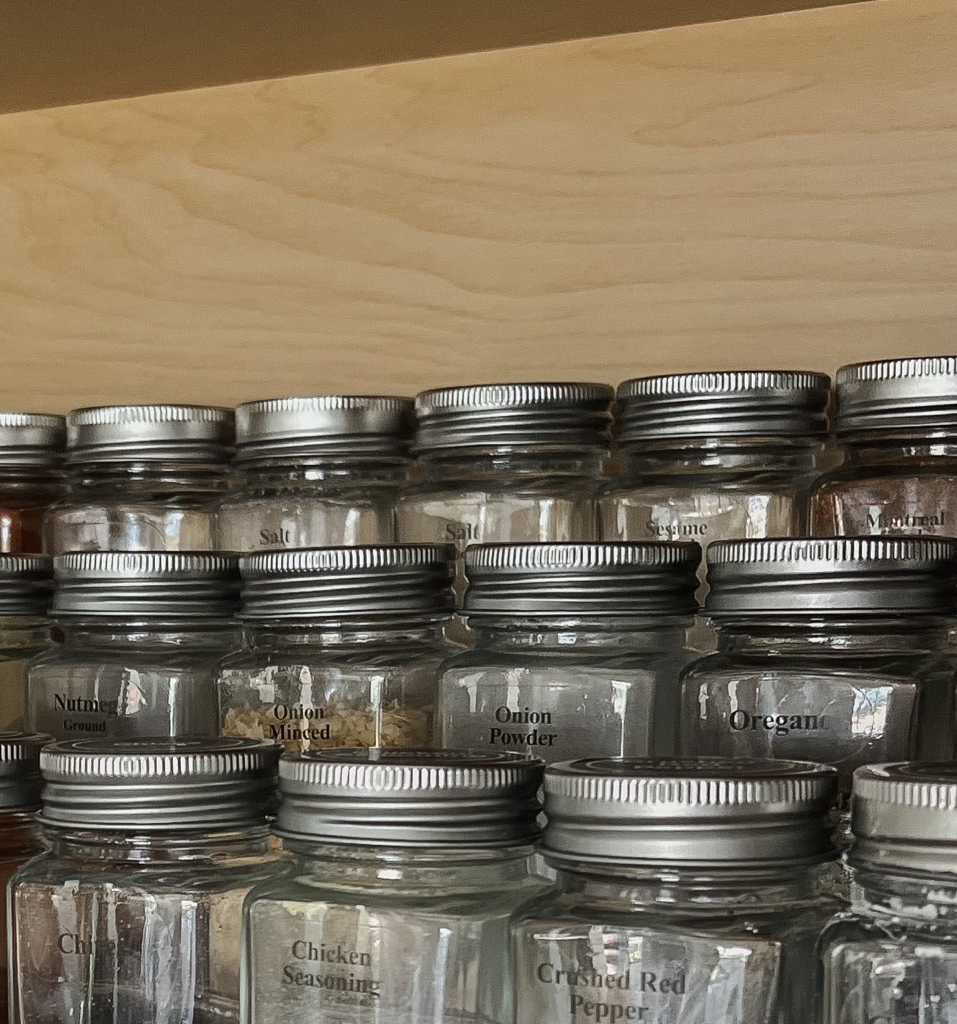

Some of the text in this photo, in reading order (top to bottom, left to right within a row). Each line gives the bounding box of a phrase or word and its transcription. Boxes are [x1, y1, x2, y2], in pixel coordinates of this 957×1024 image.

[866, 511, 945, 529] Mtreal
[259, 527, 291, 546] Salt
[273, 705, 325, 721] Onion
[495, 706, 553, 725] Onion
[63, 719, 107, 732] Ground
[268, 724, 331, 741] Minced
[490, 727, 559, 747] Powder
[292, 939, 371, 967] Chicken
[282, 965, 380, 998] Seasoning
[537, 963, 686, 995] Crushed Red
[570, 994, 647, 1023] Pepper
